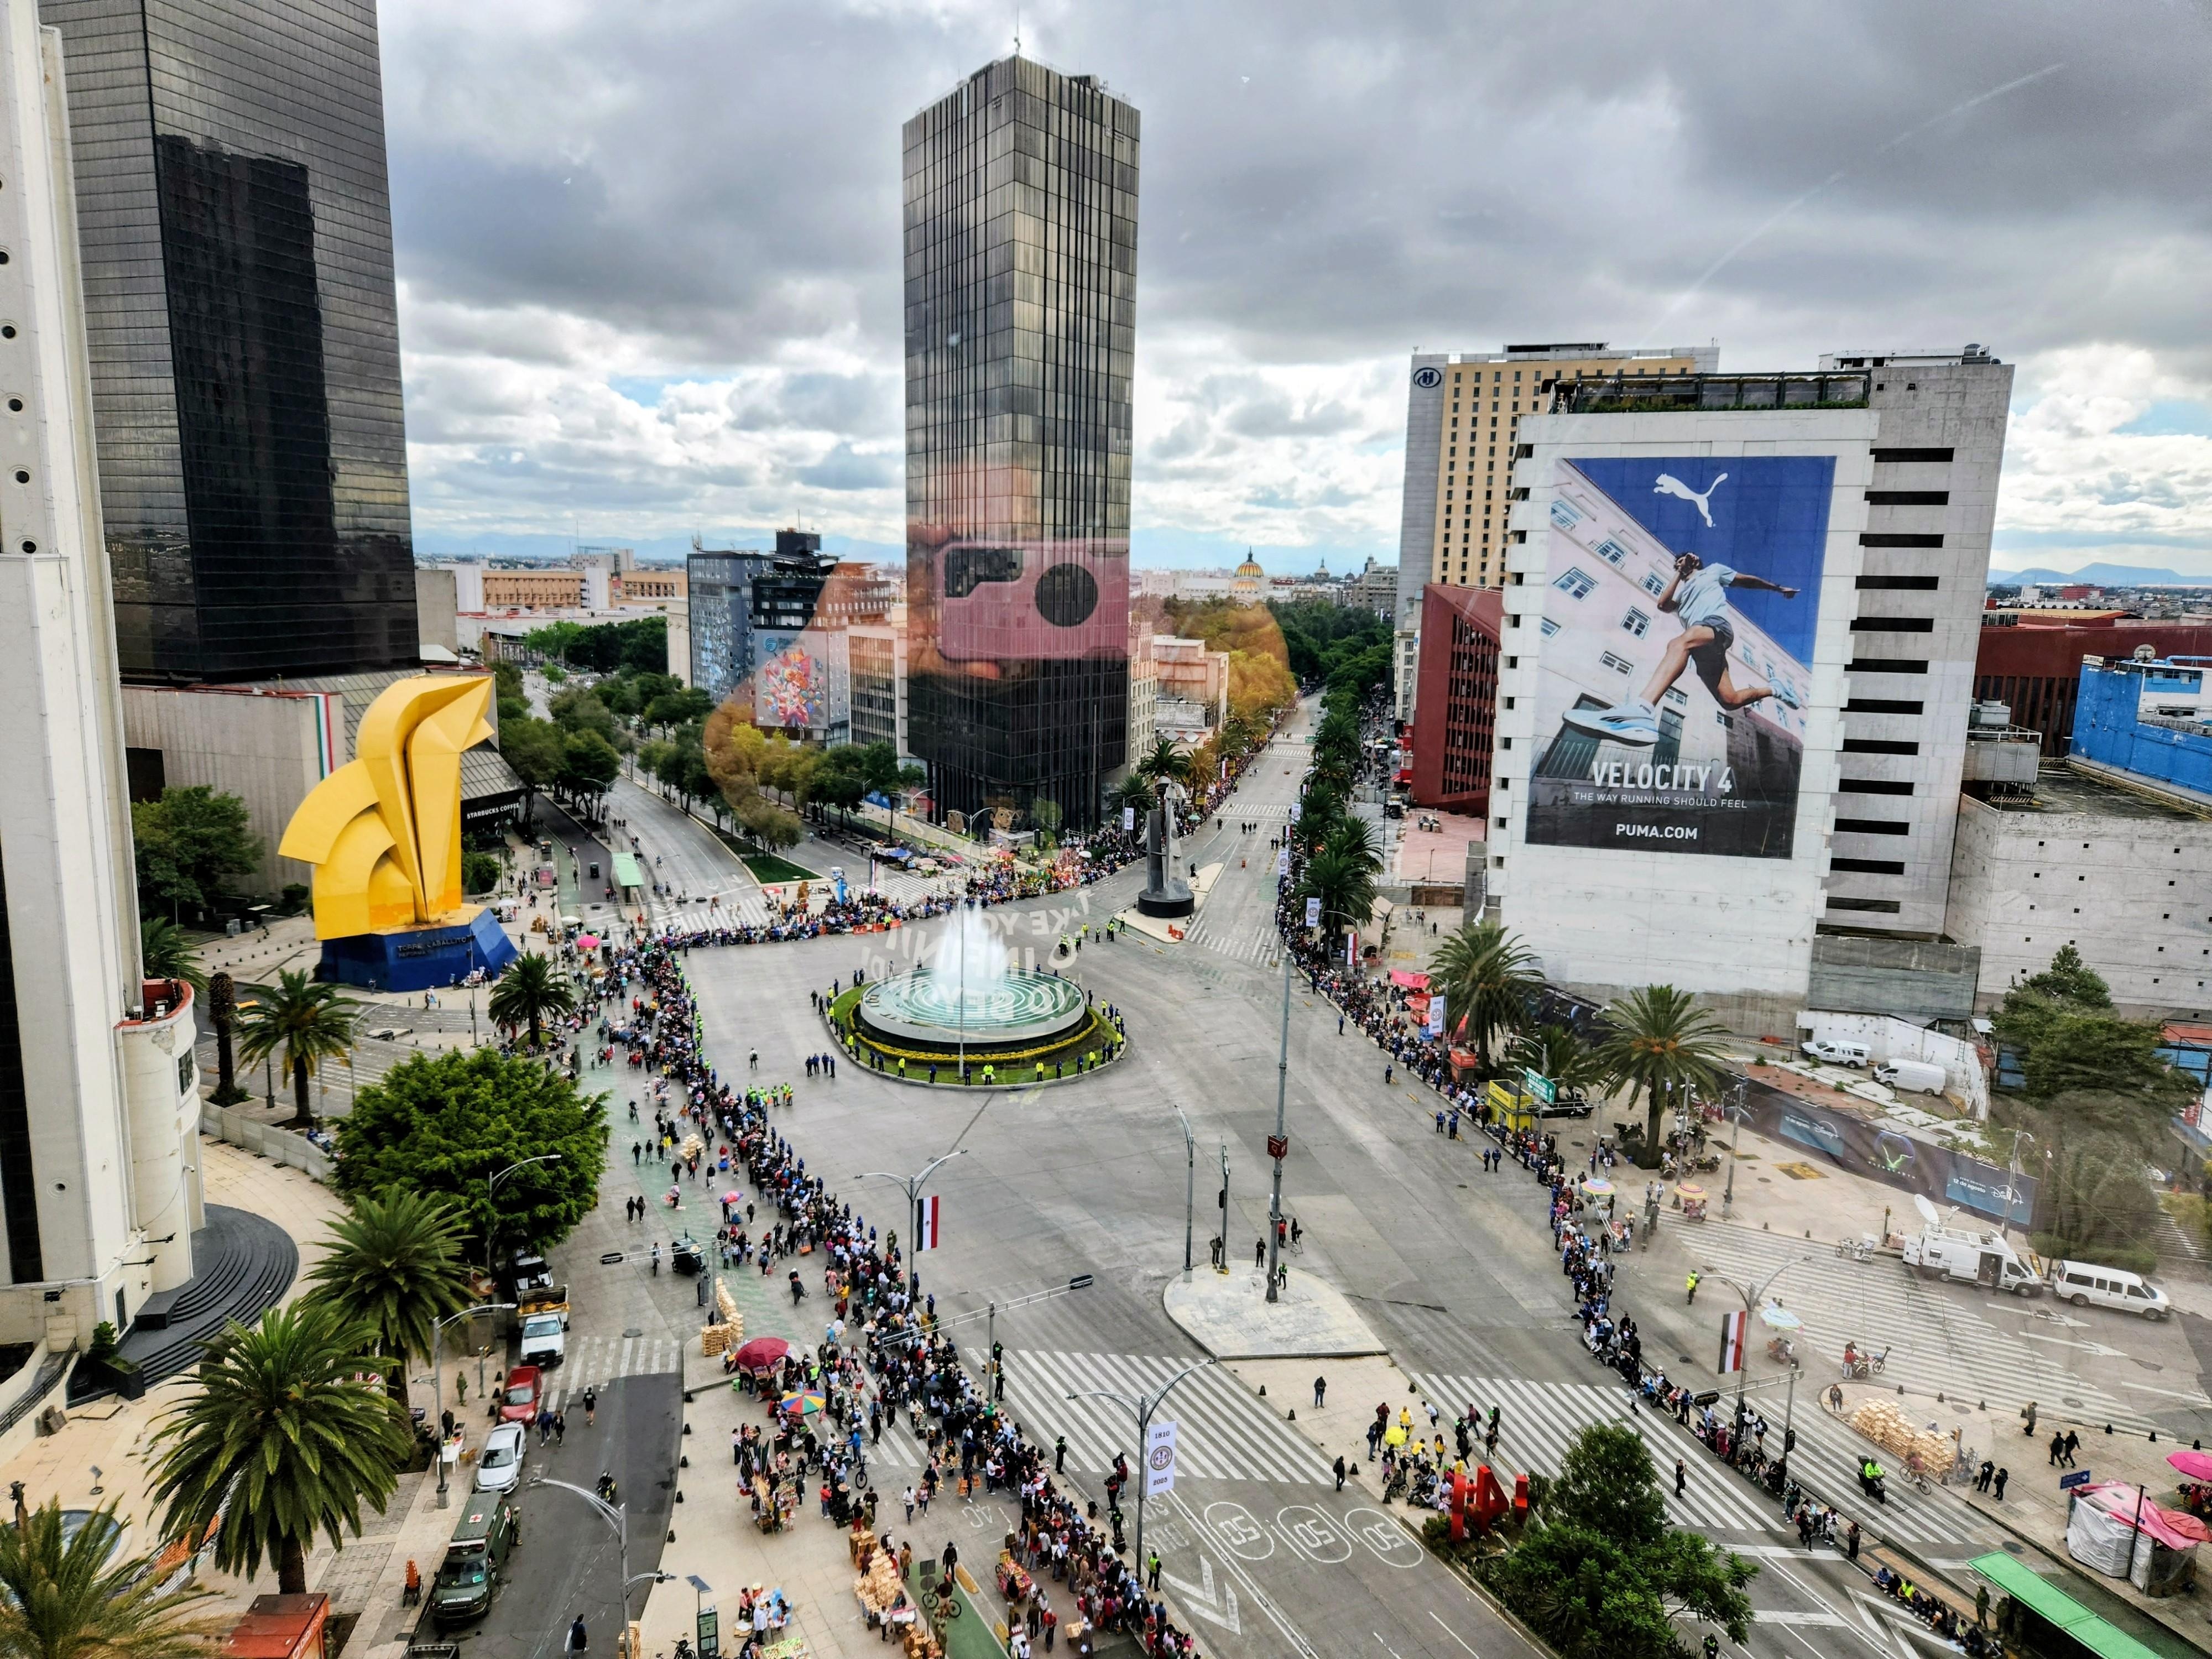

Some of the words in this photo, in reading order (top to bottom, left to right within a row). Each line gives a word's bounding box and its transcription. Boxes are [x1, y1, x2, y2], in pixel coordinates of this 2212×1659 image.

[1593, 761, 1712, 792] VELOCITY
[1717, 766, 1733, 792] 4
[1574, 791, 1594, 801] THE
[1596, 793, 1619, 802] WAY
[1621, 795, 1670, 805] RUNNING
[1673, 797, 1717, 807] SHOULD
[1720, 799, 1747, 808] FEEL
[466, 807, 499, 820] STARBUCKS
[500, 802, 520, 812] COFFEE
[1615, 823, 1698, 840] PUMA.COM
[398, 943, 423, 952] TORRE
[1967, 1183, 1986, 1193] agosto
[1155, 1431, 1170, 1439] 1810
[1152, 1477, 1168, 1486] 2025
[1219, 1515, 1261, 1546] 50
[1293, 1519, 1335, 1548] 50
[1362, 1522, 1406, 1552] 50
